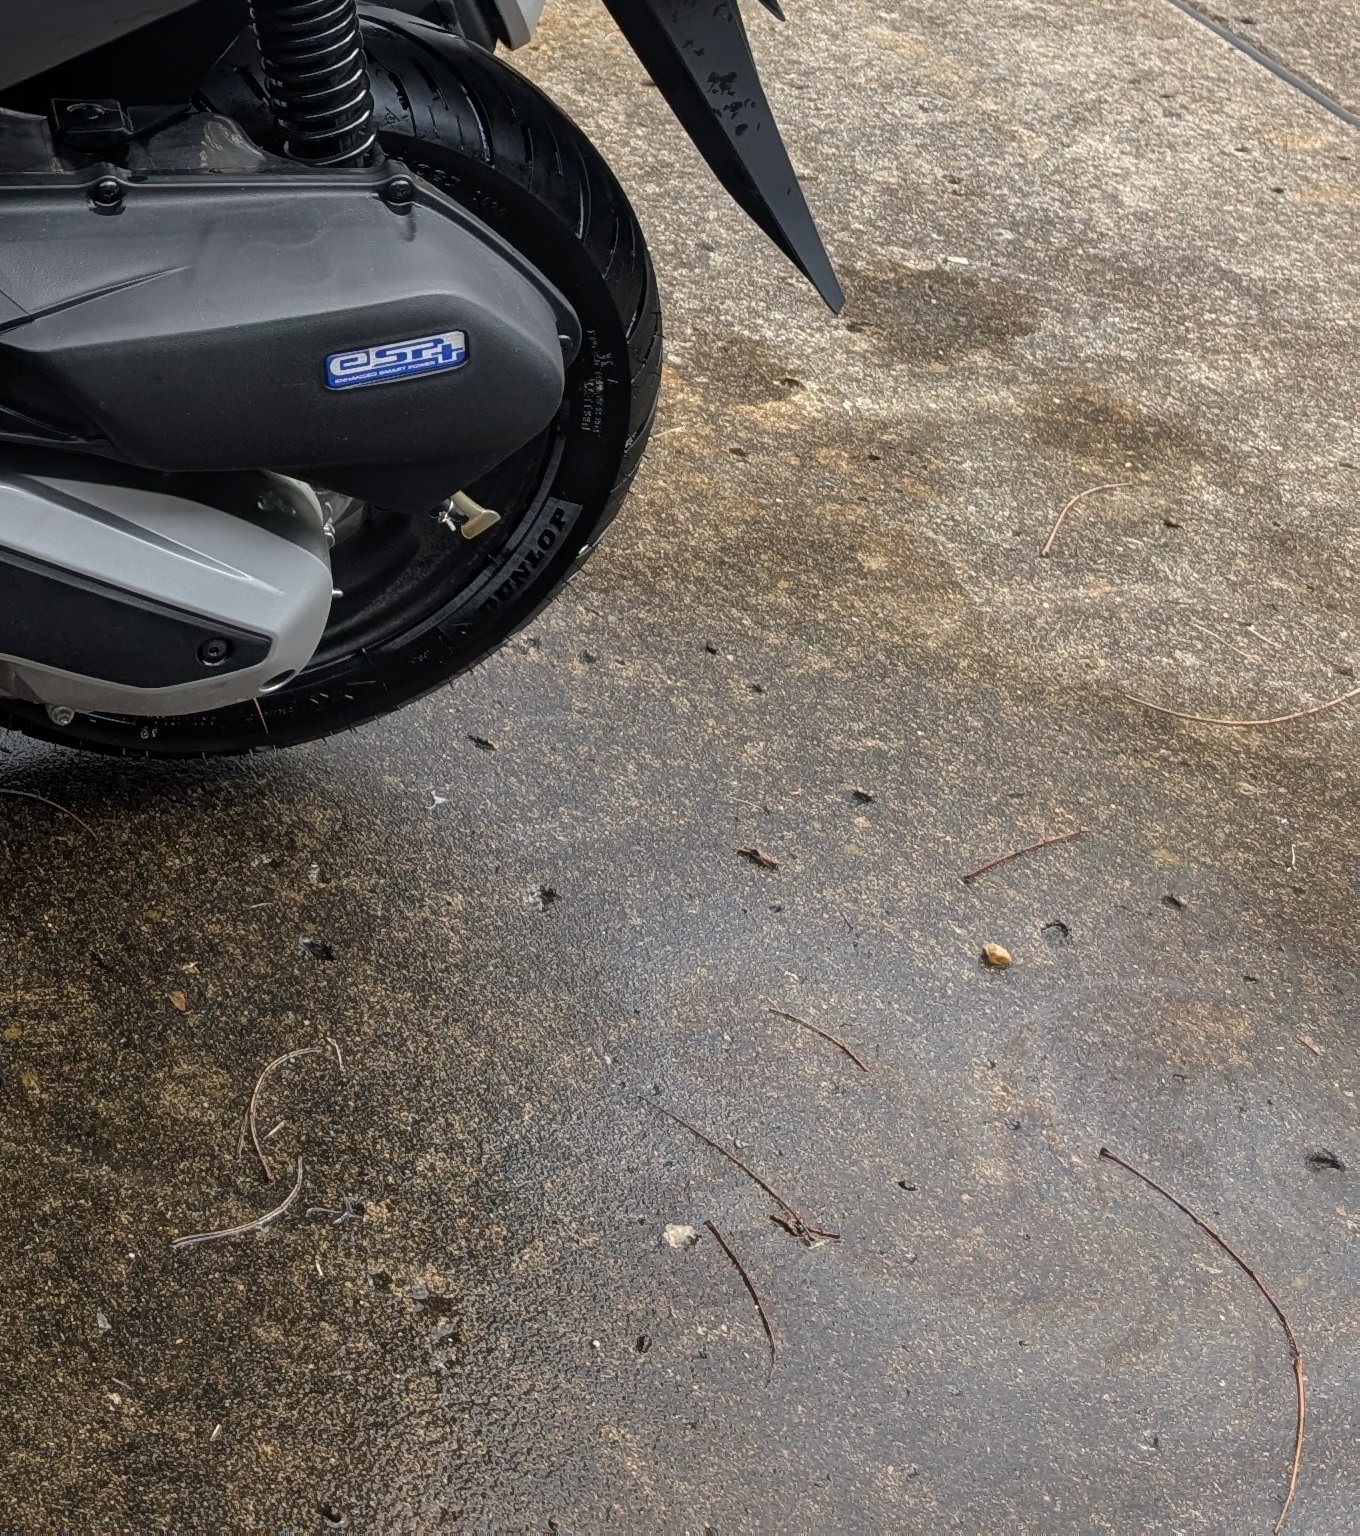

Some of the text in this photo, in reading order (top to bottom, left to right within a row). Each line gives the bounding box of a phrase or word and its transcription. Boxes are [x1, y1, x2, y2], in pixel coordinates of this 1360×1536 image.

[334, 360, 436, 384] ENHANCED SMART POWER
[477, 507, 566, 612] DUNLOP
